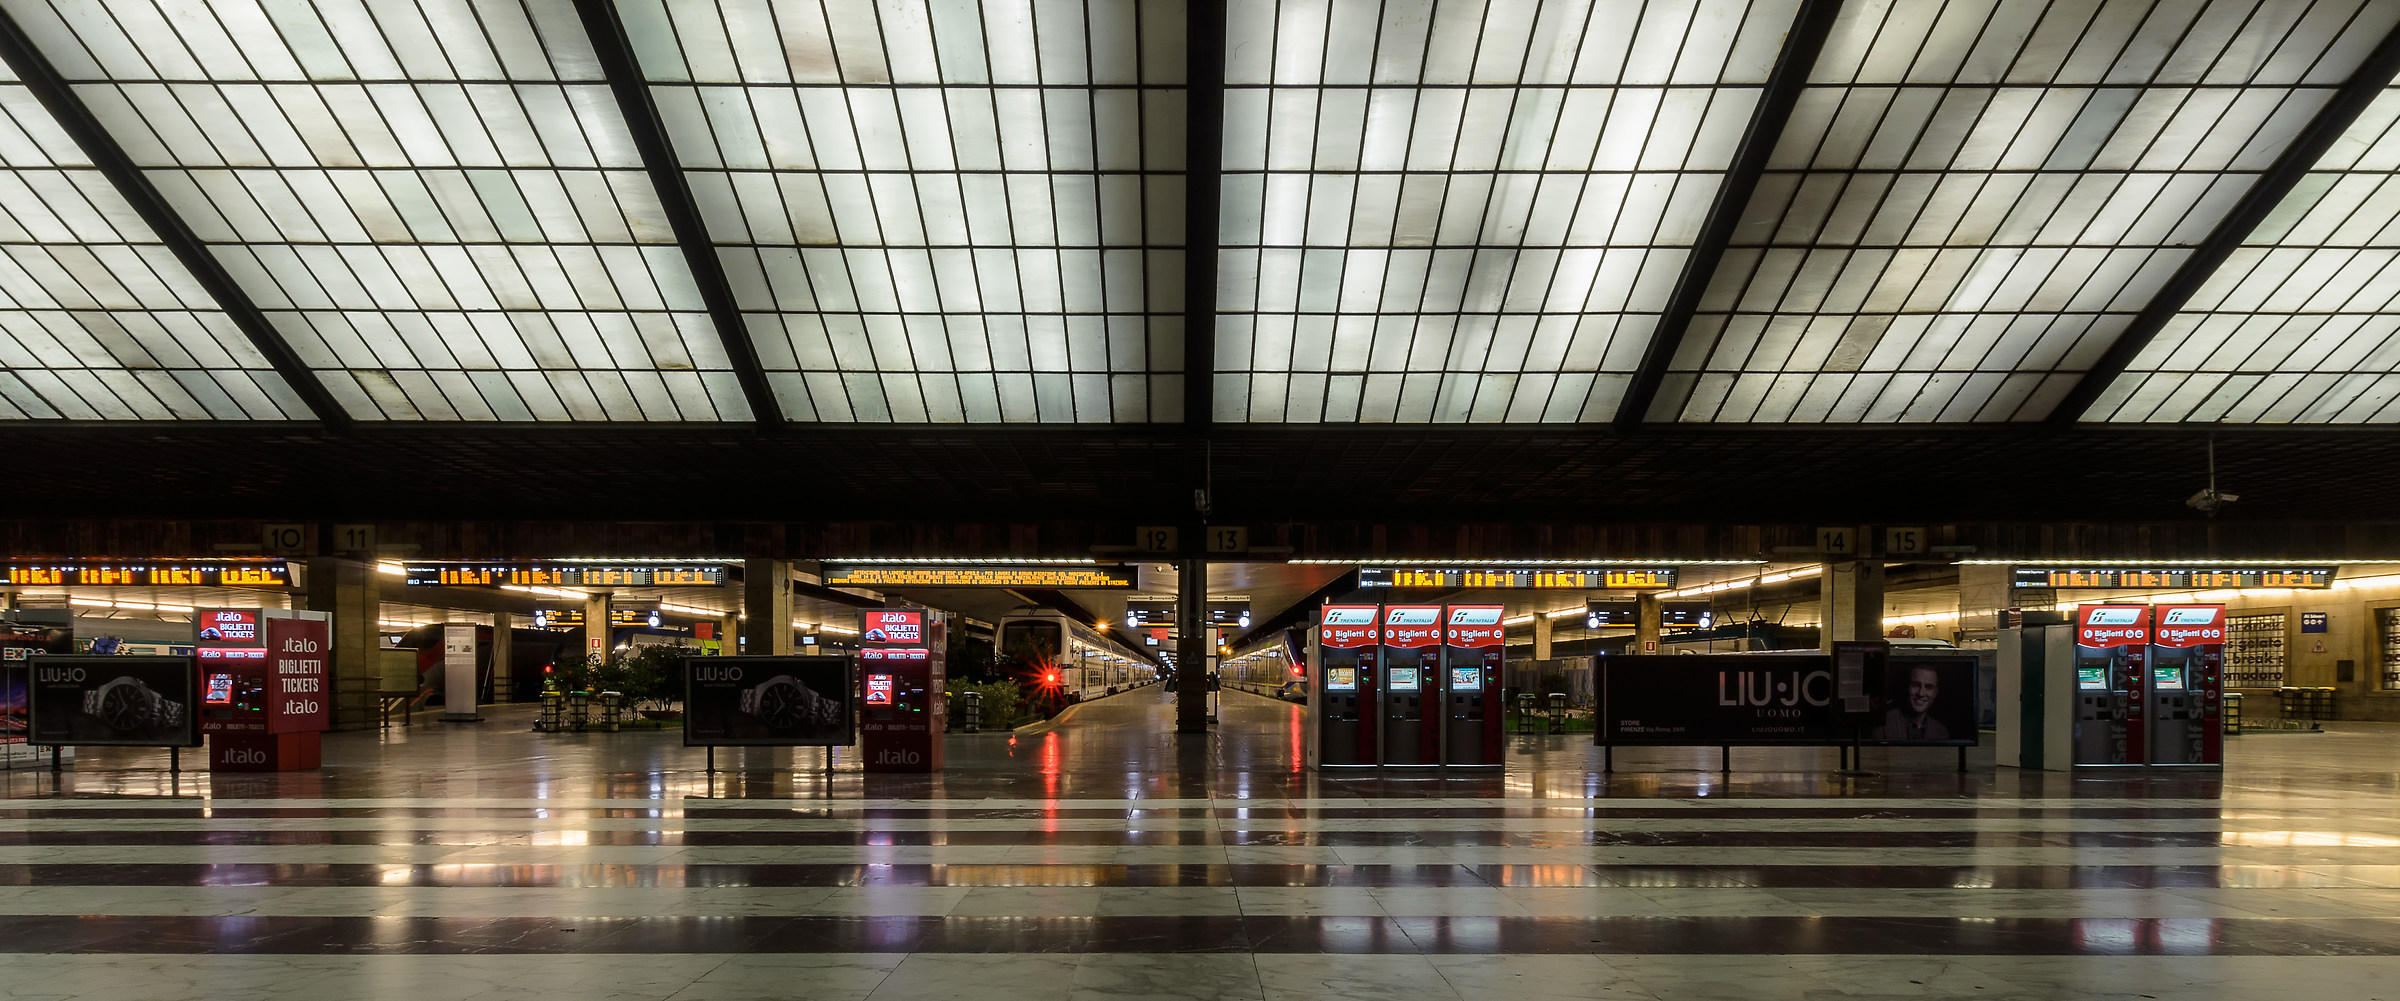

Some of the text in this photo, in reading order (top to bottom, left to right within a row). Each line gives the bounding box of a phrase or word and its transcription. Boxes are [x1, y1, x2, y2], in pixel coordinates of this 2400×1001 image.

[271, 528, 300, 549] 10
[347, 528, 366, 549] 11
[1146, 530, 1167, 551] 12
[1217, 530, 1237, 551] 13
[1824, 531, 1845, 551] 14
[1894, 531, 1916, 551] 15
[219, 623, 254, 631] BIGLIETTI
[884, 624, 919, 632] BIGLIETTI
[889, 632, 919, 640] TICKETS
[1335, 630, 1365, 638] Biglietti
[1398, 630, 1428, 638] Biglietti
[1461, 630, 1491, 638] Biglietti
[2094, 629, 2124, 638] Biglietti
[2170, 629, 2200, 638] Biglietti
[279, 659, 321, 674] BIGLIETTI
[281, 678, 319, 693] TICKETS
[1756, 709, 1801, 718] UOMO
